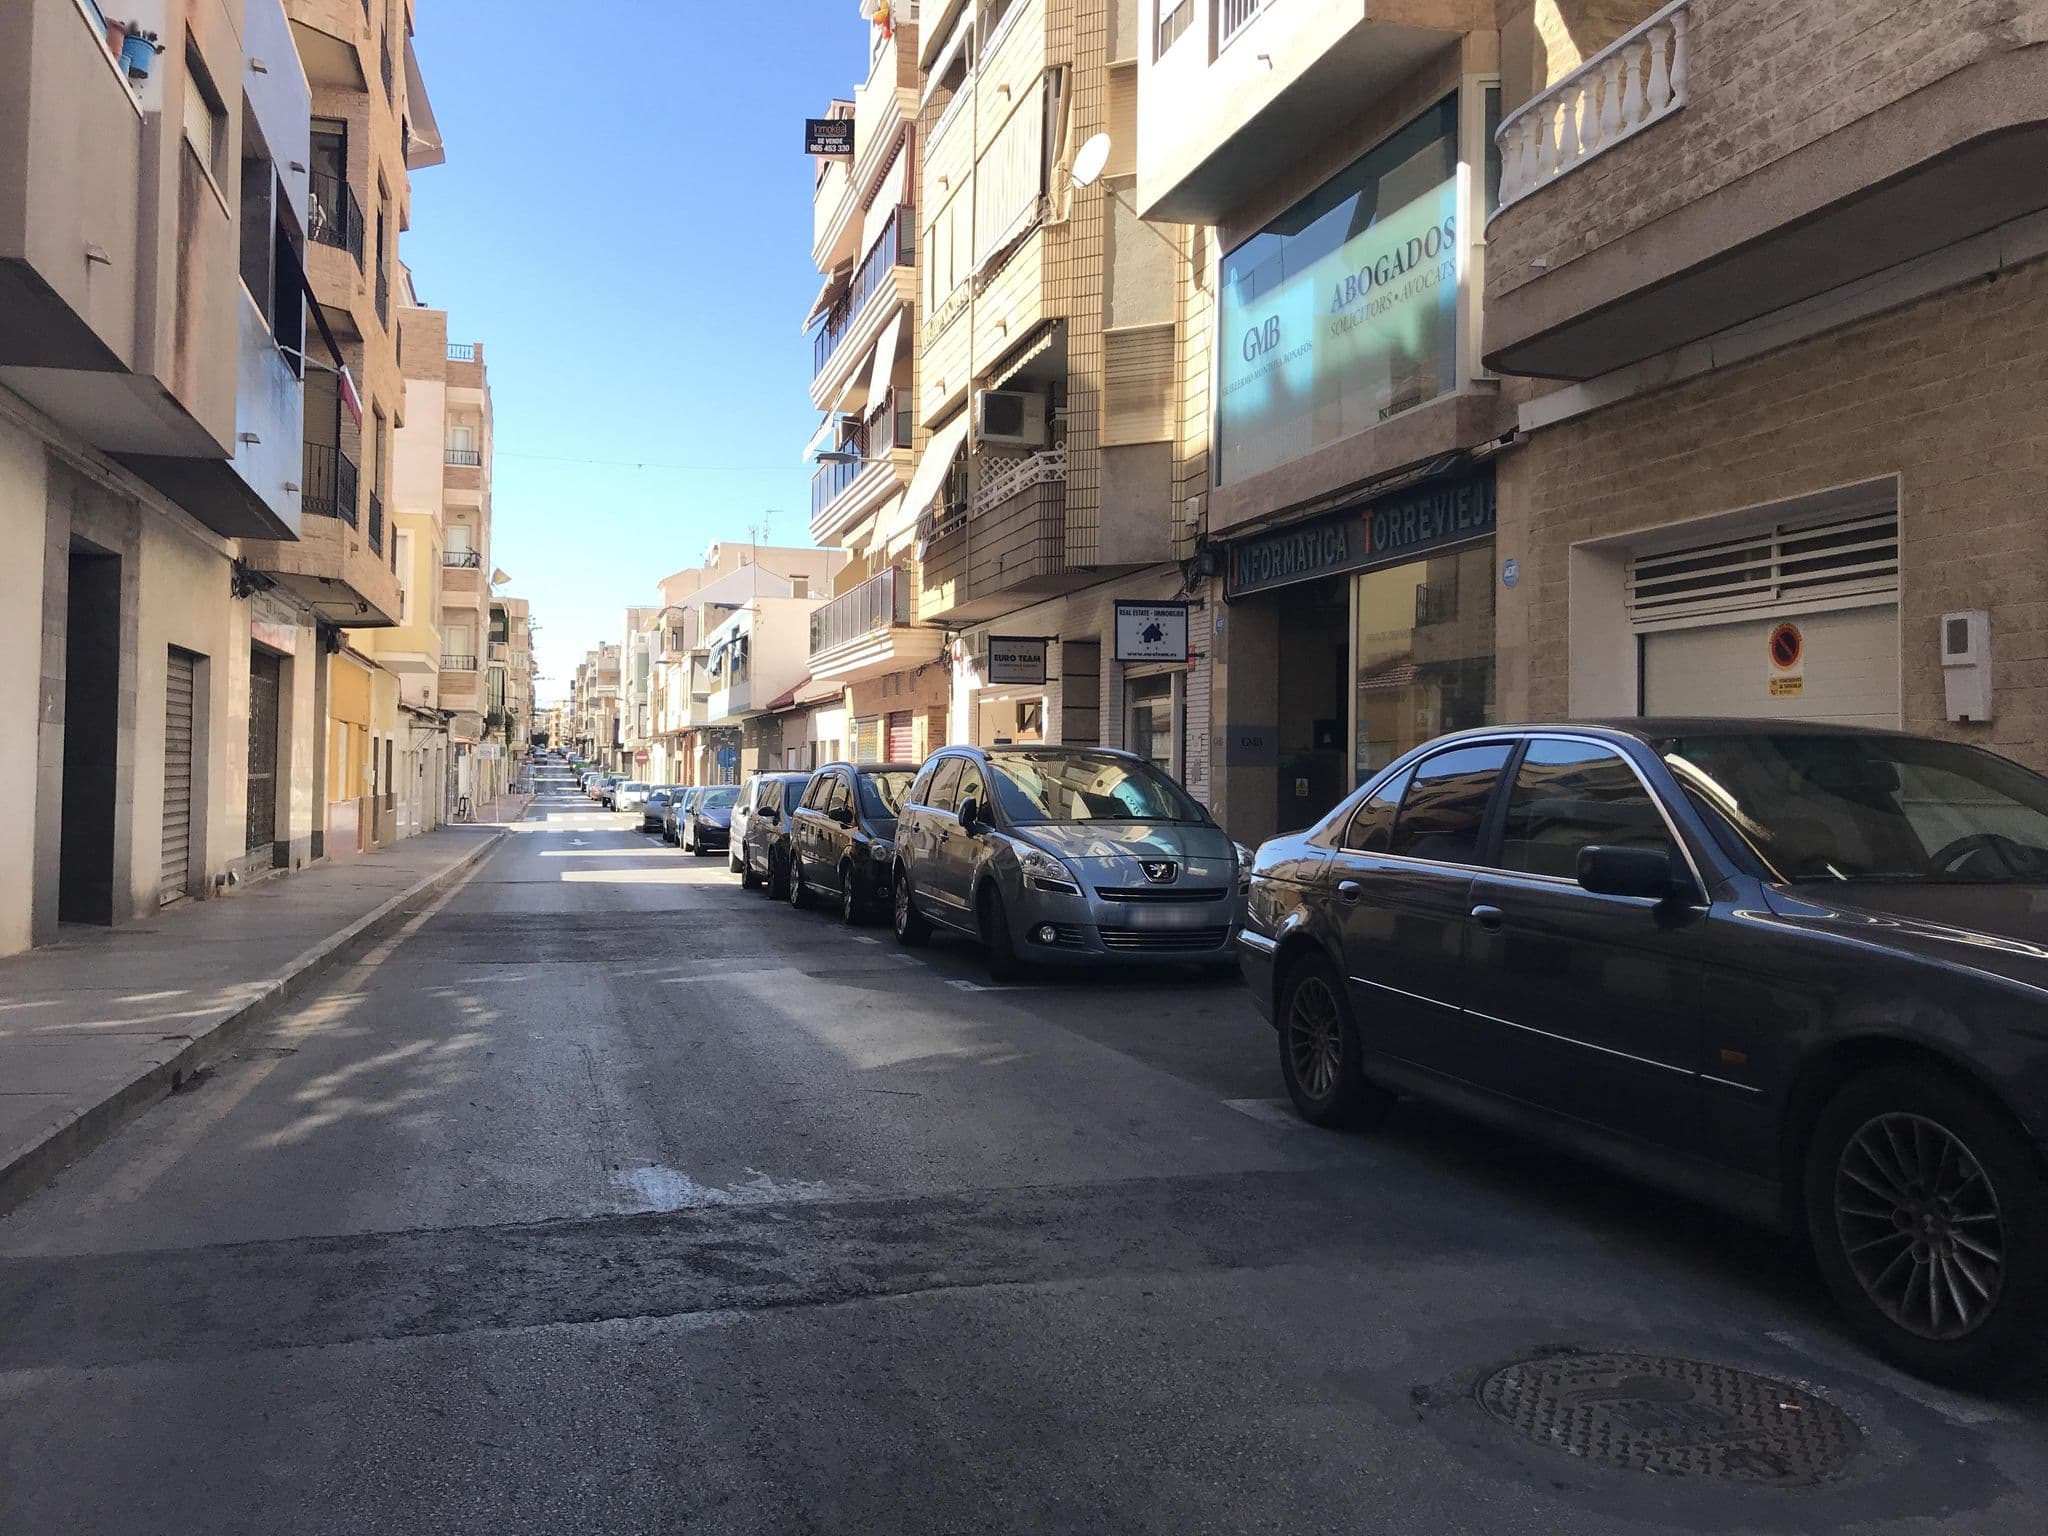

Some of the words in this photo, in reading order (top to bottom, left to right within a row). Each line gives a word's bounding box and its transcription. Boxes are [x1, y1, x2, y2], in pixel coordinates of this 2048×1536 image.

[1330, 215, 1456, 313] ABOGADOS
[1330, 292, 1393, 337] SOLICITORS
[1400, 257, 1456, 301] AVOCATS
[1242, 314, 1281, 362] GMB
[1233, 527, 1347, 587] INFORMATICA
[1362, 480, 1496, 554] TORREVIEJA
[1119, 609, 1131, 617] REAL
[1132, 609, 1150, 617] ESTATE
[994, 654, 1016, 662] EURO
[1018, 655, 1041, 663] TEAM
